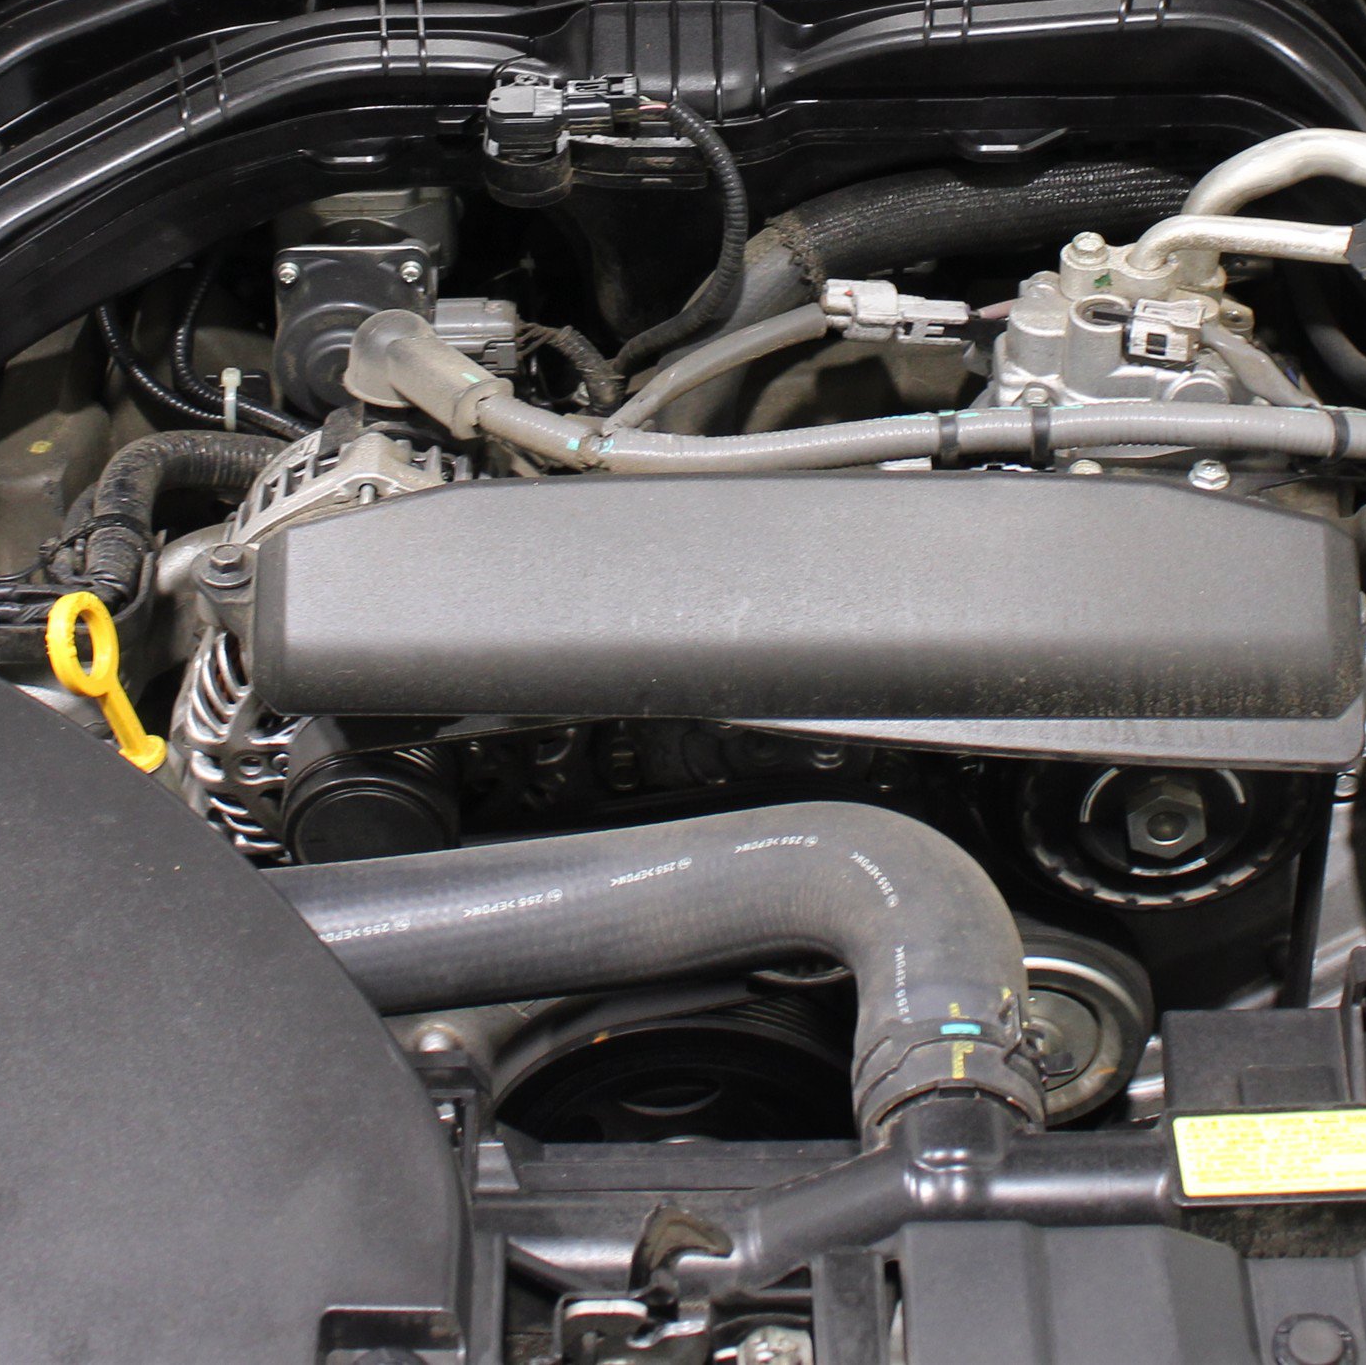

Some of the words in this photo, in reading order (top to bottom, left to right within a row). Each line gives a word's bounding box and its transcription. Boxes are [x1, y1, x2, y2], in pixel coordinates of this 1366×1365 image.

[780, 835, 804, 846] 255
[654, 860, 677, 876] 255
[518, 892, 544, 907] 255
[361, 920, 390, 936] 255
